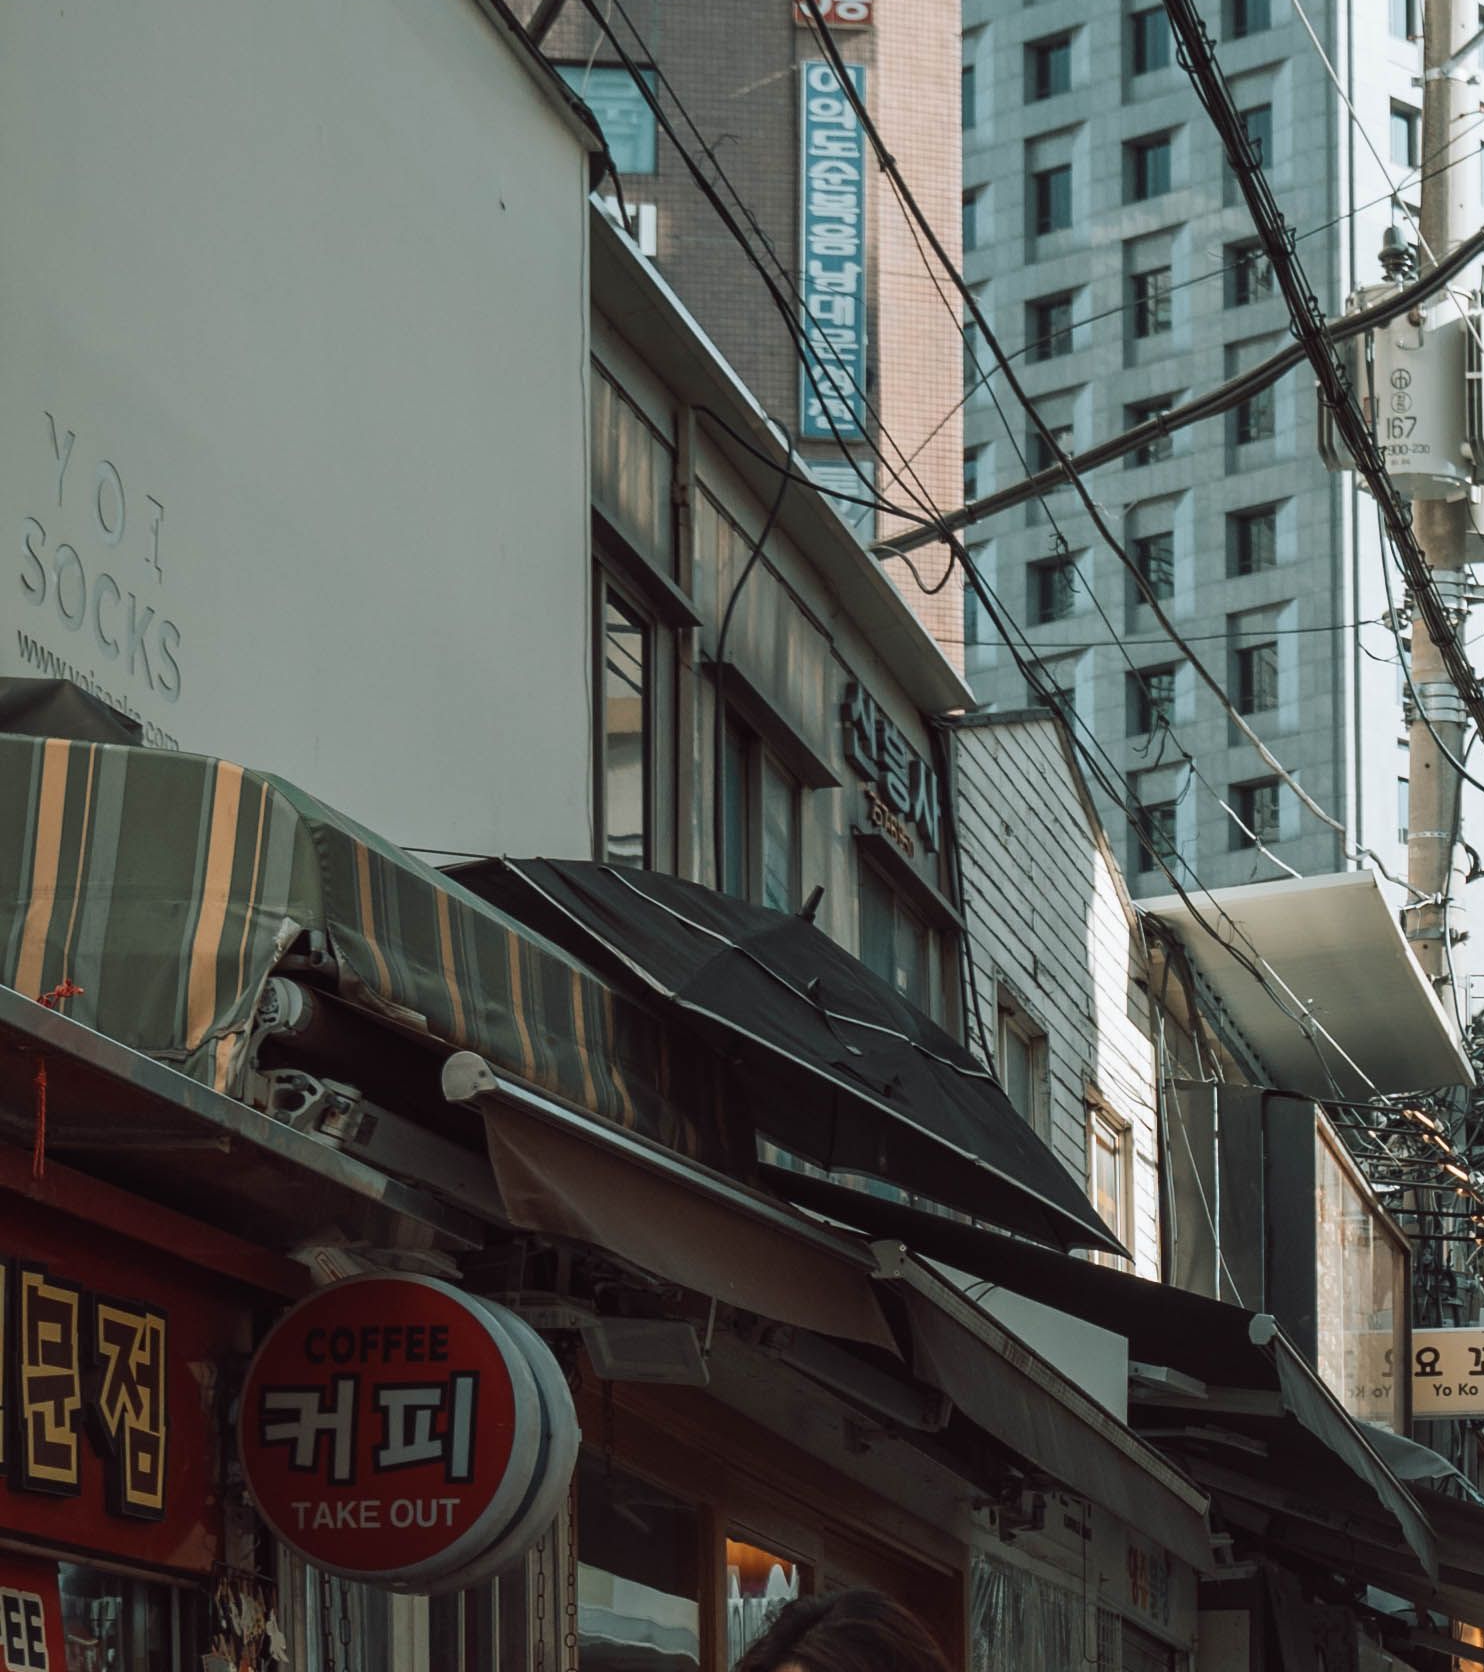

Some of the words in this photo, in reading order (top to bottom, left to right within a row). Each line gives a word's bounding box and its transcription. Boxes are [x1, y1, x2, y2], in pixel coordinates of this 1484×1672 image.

[1386, 416, 1417, 440] 167
[20, 516, 182, 704] SOCKS
[305, 1325, 450, 1365] COFFEE
[1414, 1346, 1443, 1377] 요
[0, 1262, 168, 1520] 문점
[1432, 1383, 1452, 1397] Yo
[1458, 1383, 1479, 1396] Ko
[258, 1370, 480, 1486] 커피
[292, 1499, 381, 1530] TAKE
[390, 1496, 461, 1528] OUT
